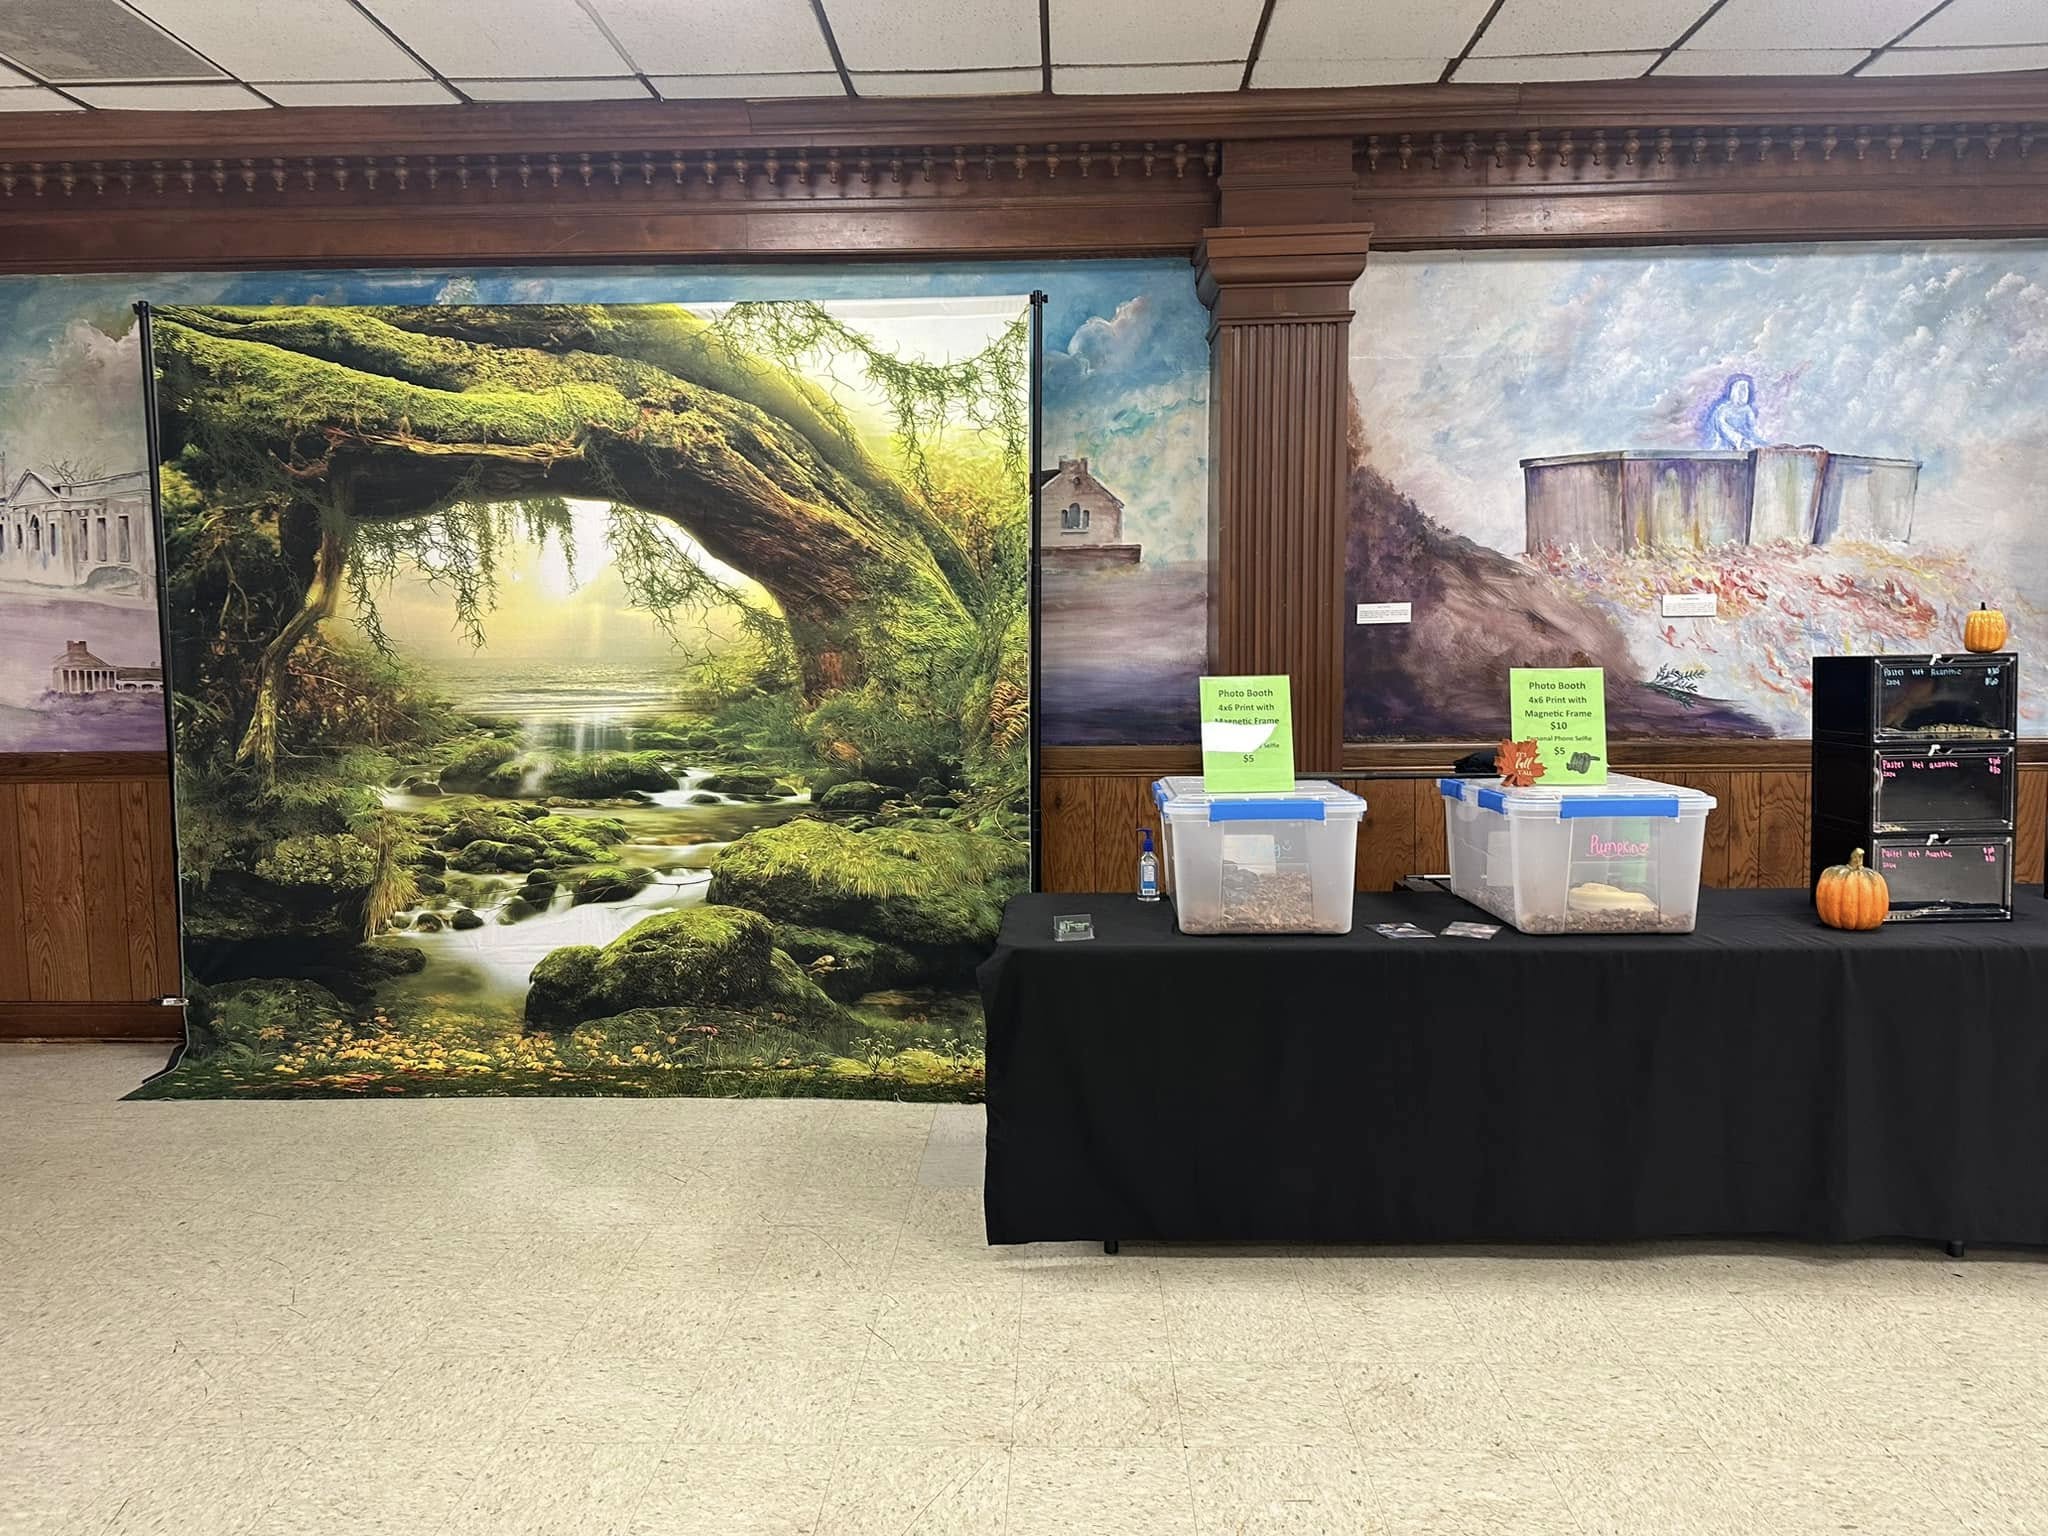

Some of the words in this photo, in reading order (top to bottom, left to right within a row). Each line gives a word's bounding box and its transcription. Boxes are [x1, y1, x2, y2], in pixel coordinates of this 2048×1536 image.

[1528, 681, 1556, 690] Photo
[1558, 681, 1586, 690] Booth
[1218, 689, 1245, 698] Photo
[1247, 689, 1274, 698] Booth
[1528, 696, 1544, 704] 4x6
[1545, 696, 1566, 704] Print
[1568, 695, 1587, 704] with
[1218, 703, 1233, 712] 4x6
[1234, 703, 1254, 712] Print
[1256, 703, 1275, 711] with
[1524, 709, 1563, 719] Magnetic
[1566, 709, 1592, 718] Frame
[1254, 717, 1280, 725] Frame
[1550, 721, 1568, 731] $10
[1554, 746, 1566, 756] $5
[1243, 754, 1255, 764] $5
